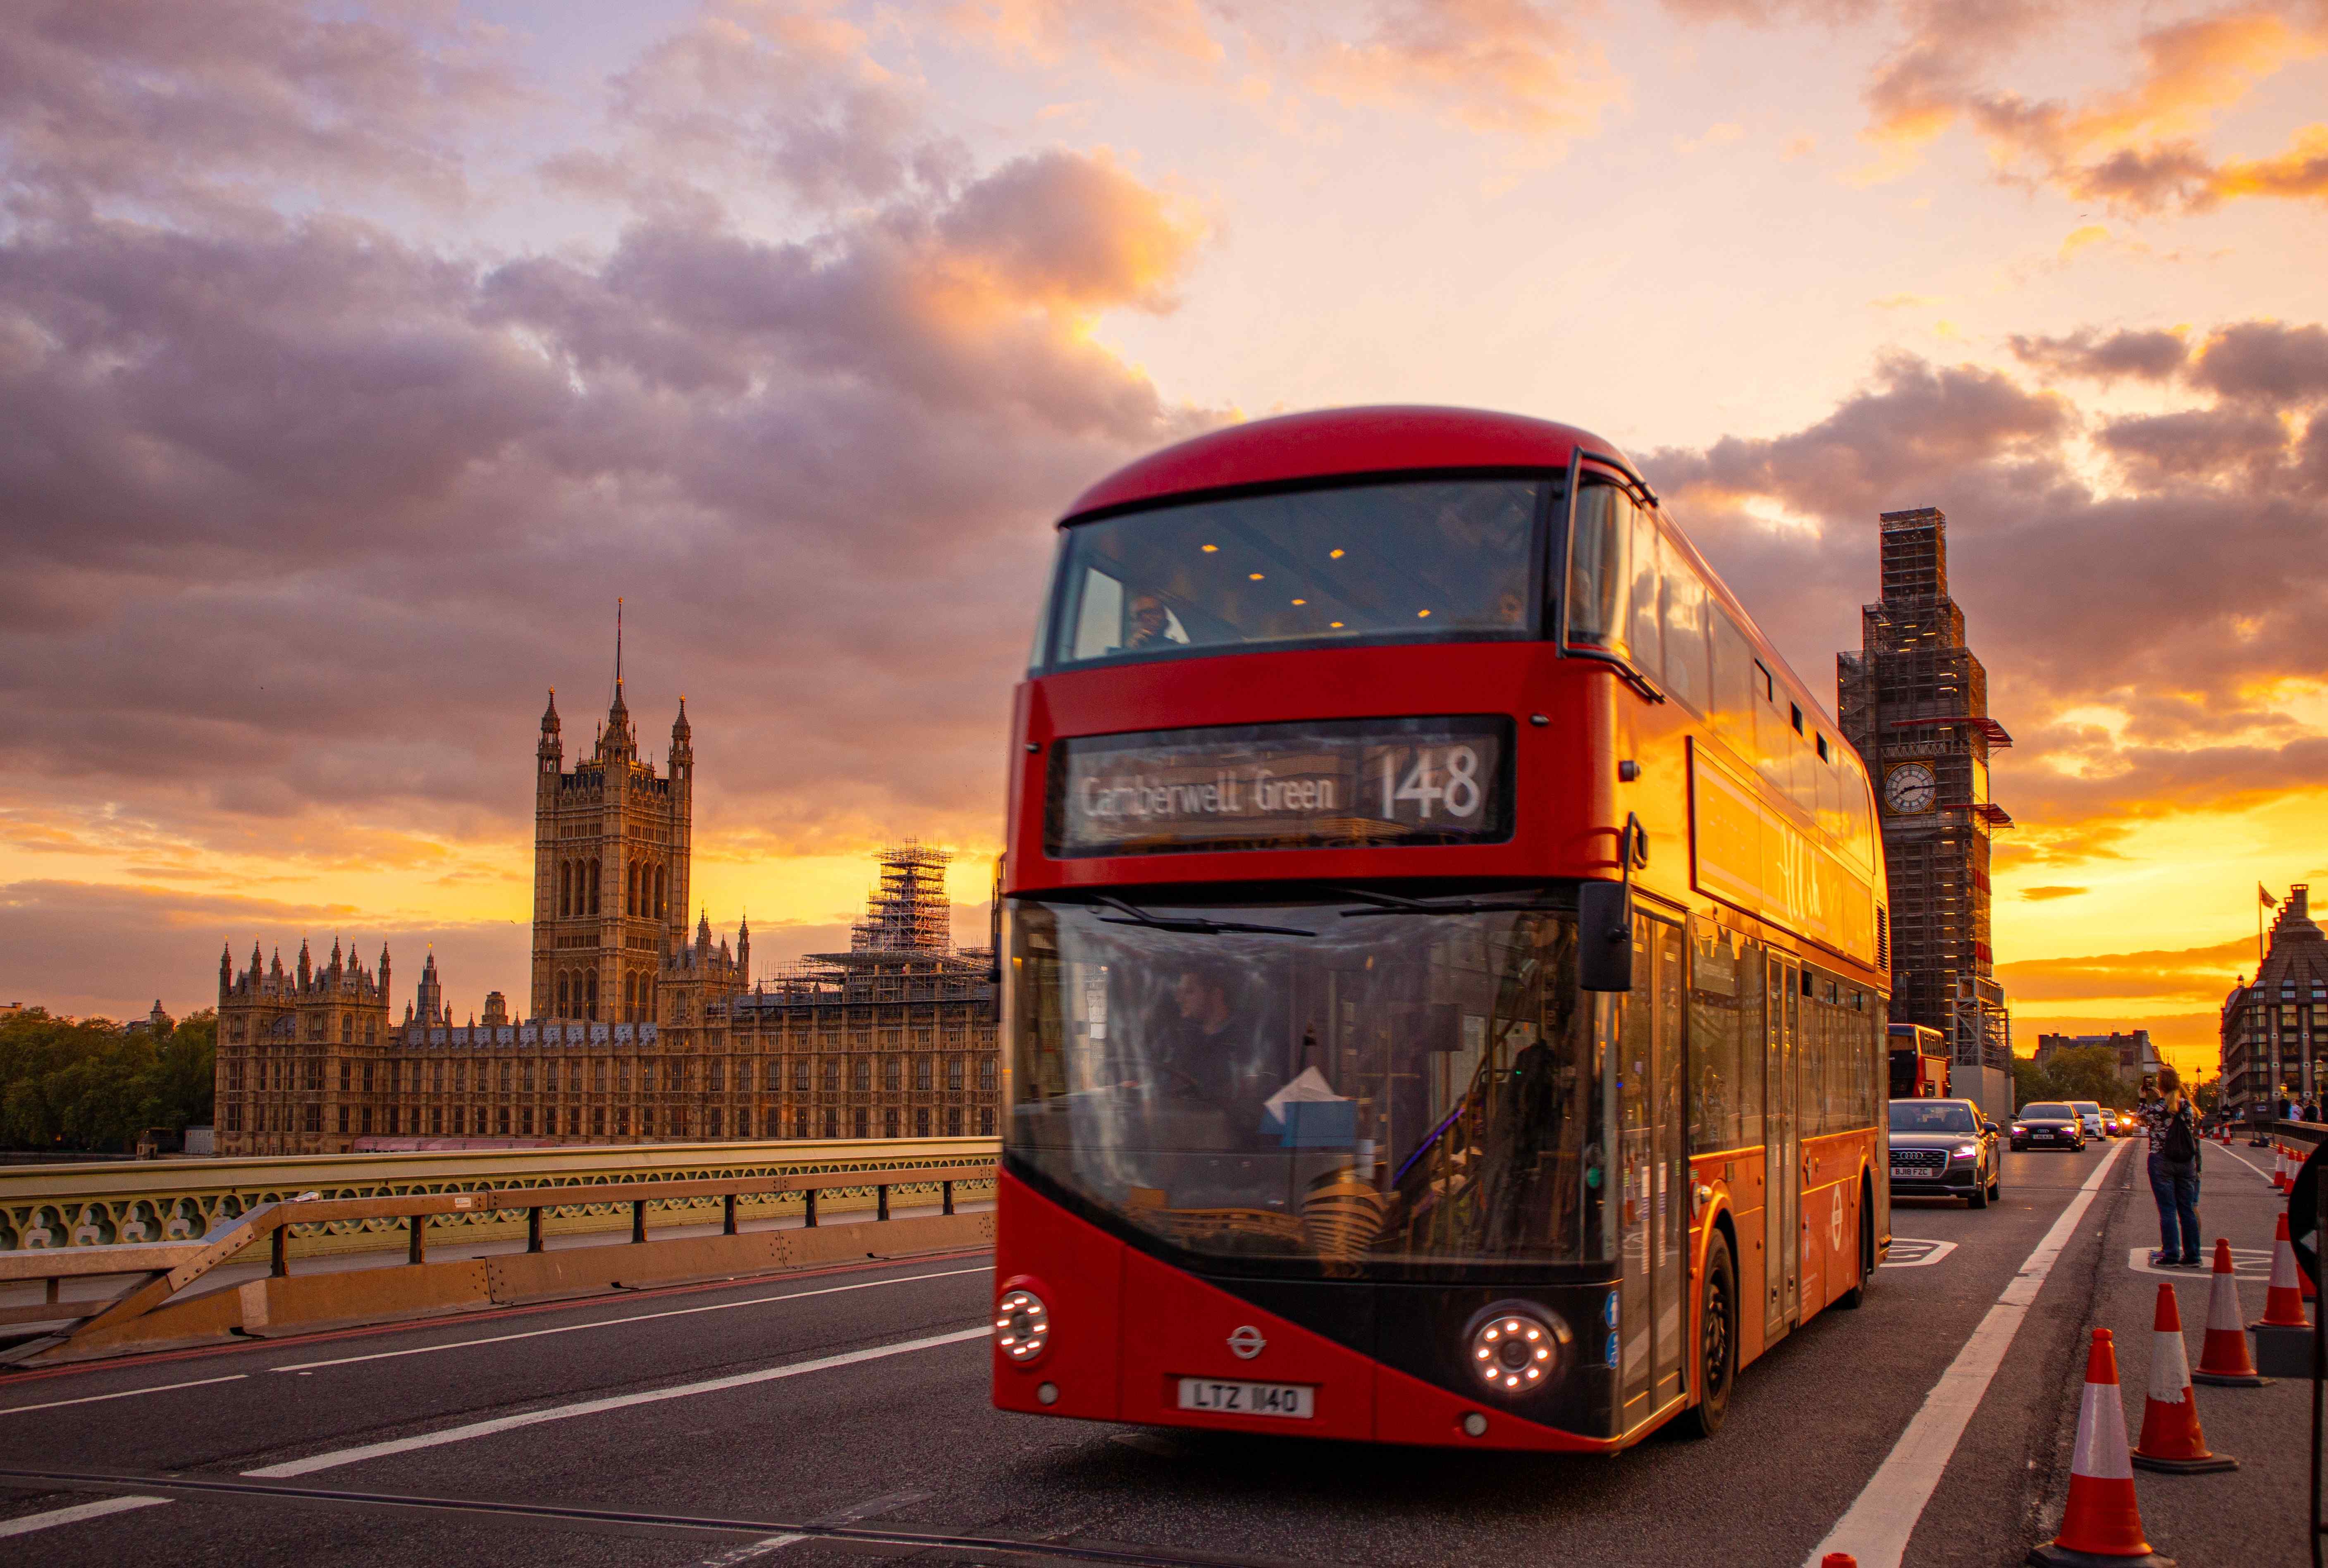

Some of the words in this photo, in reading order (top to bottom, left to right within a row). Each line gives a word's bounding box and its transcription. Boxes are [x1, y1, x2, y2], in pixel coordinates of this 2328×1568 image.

[1254, 769, 1334, 812] Green
[1380, 745, 1480, 819] 148
[1194, 1384, 1241, 1409] LTZ
[1252, 1387, 1298, 1412] 1140
